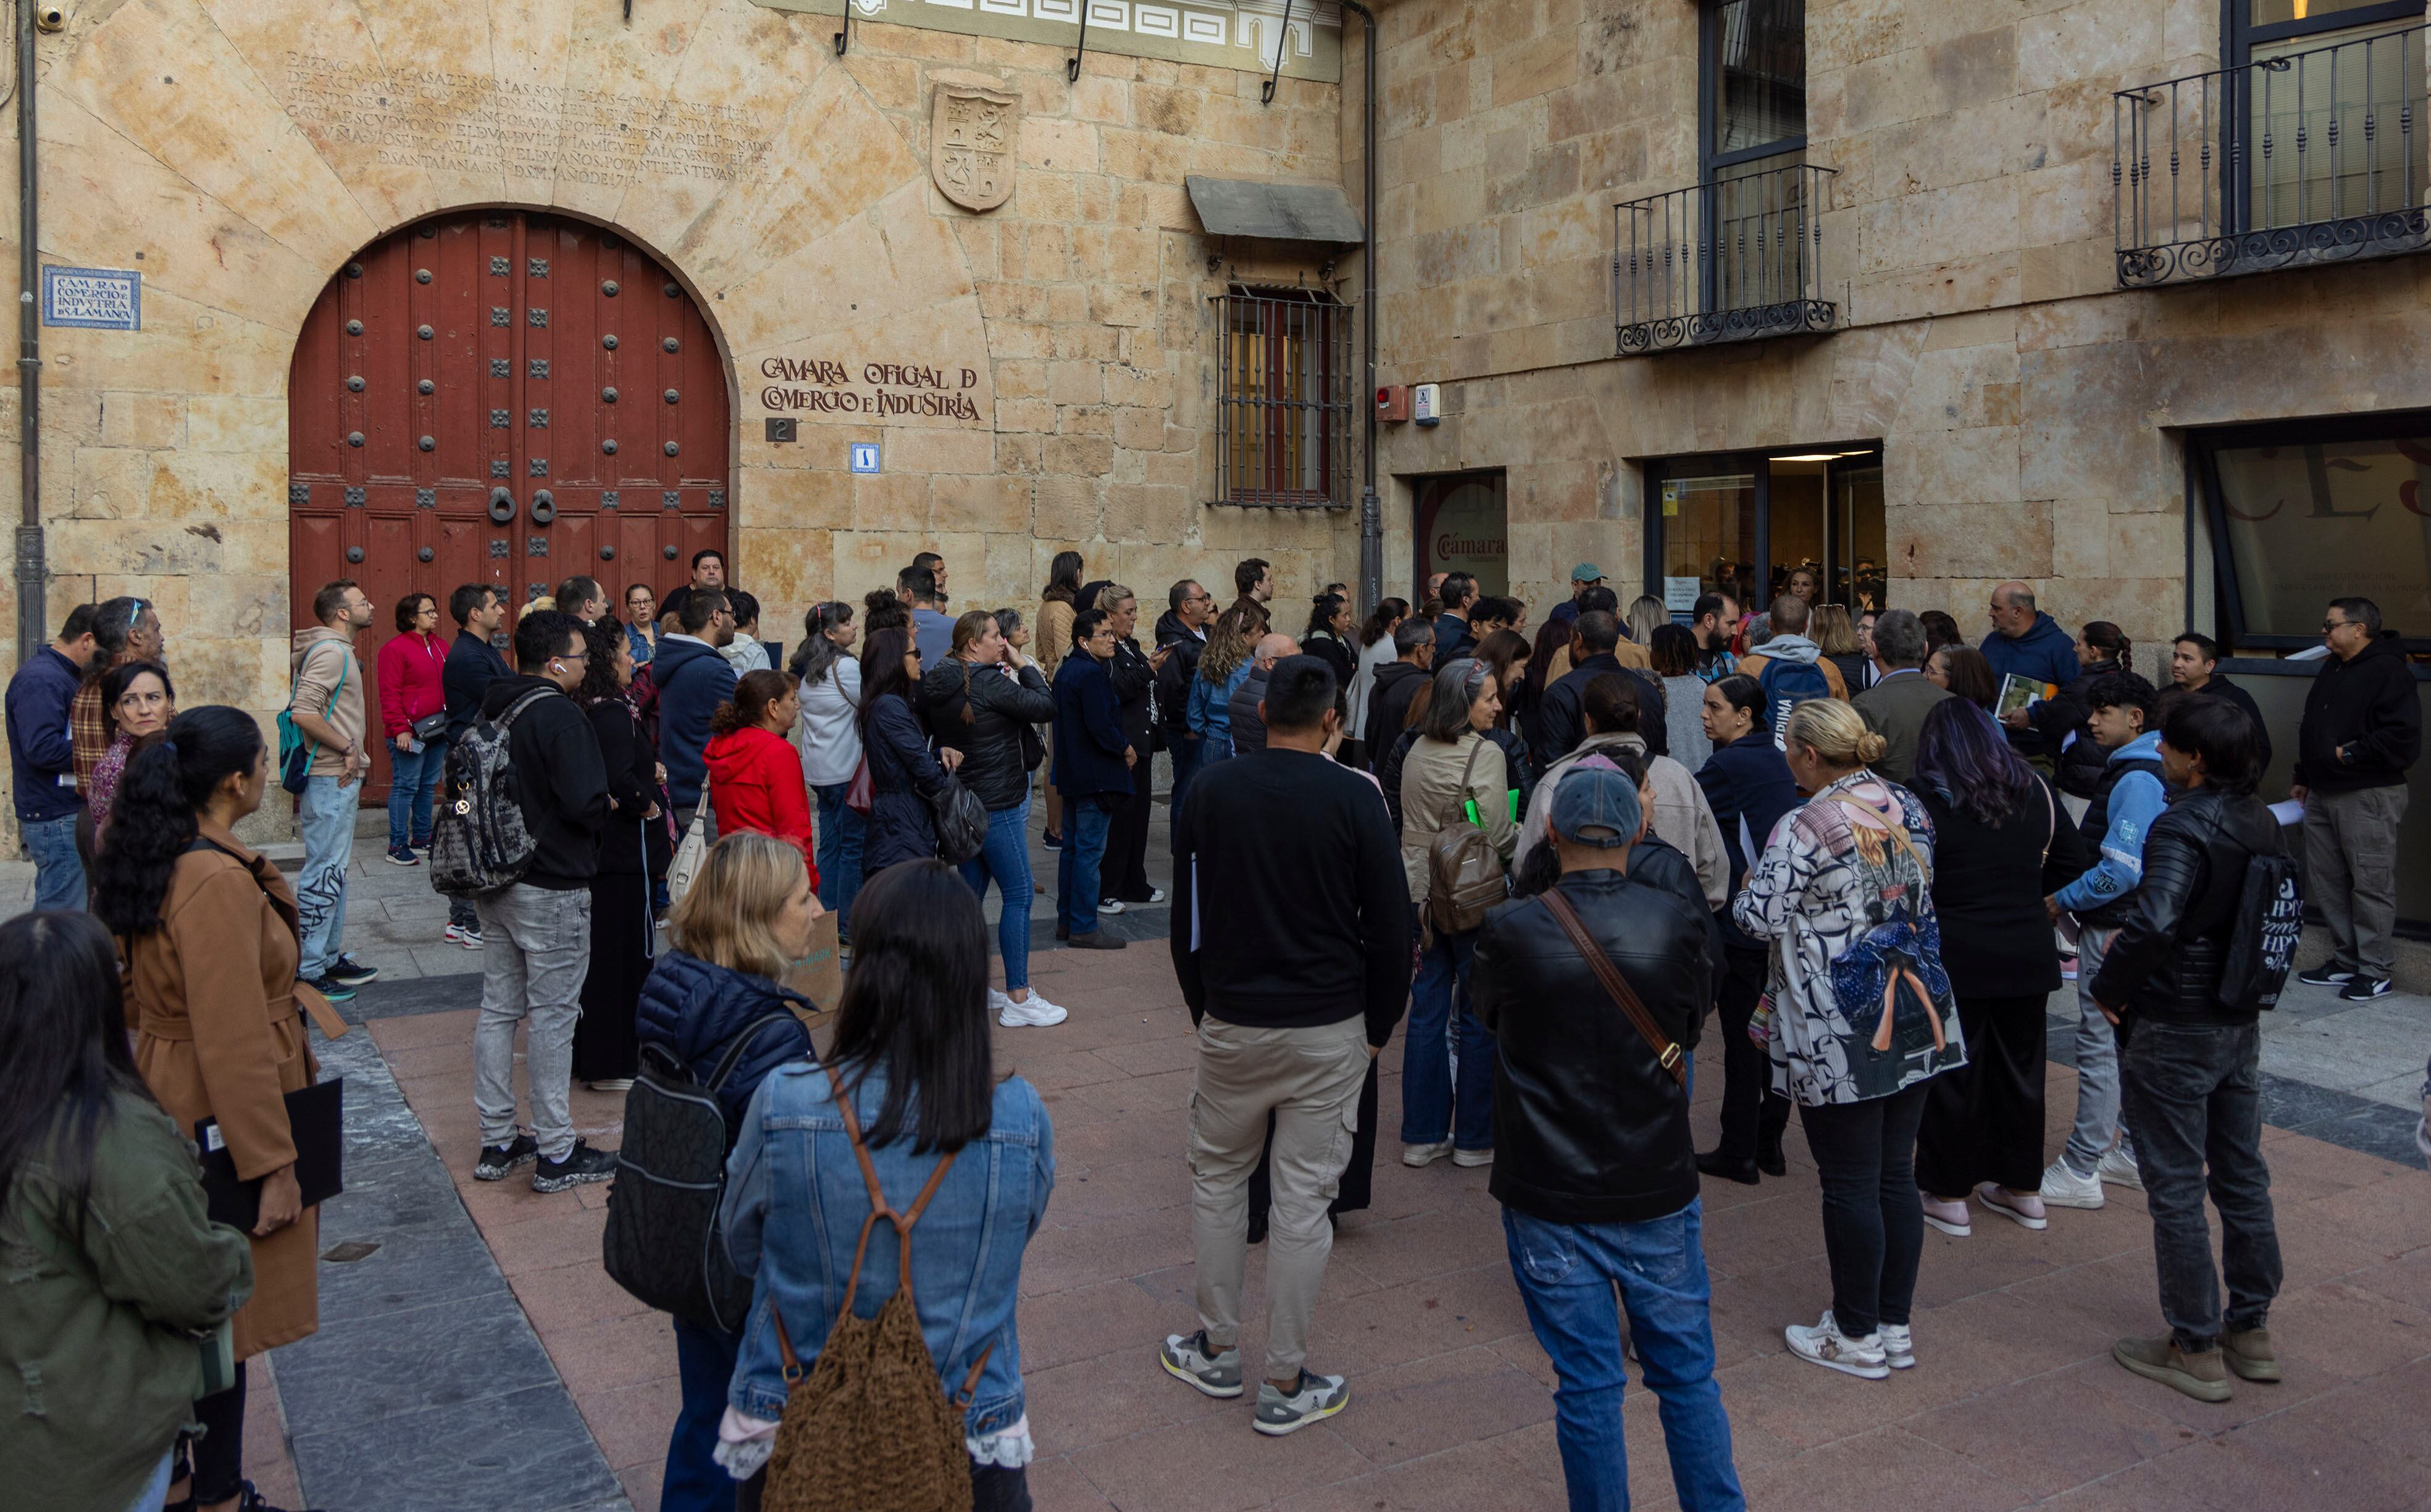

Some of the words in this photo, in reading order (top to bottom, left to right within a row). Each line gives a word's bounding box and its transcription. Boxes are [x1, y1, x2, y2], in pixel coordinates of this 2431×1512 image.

[57, 287, 120, 299] COMERCIO
[761, 384, 859, 413] COMERCIO
[875, 388, 983, 421] INDUSTRIA
[775, 419, 788, 440] 2
[1775, 699, 1792, 733] PUMA
